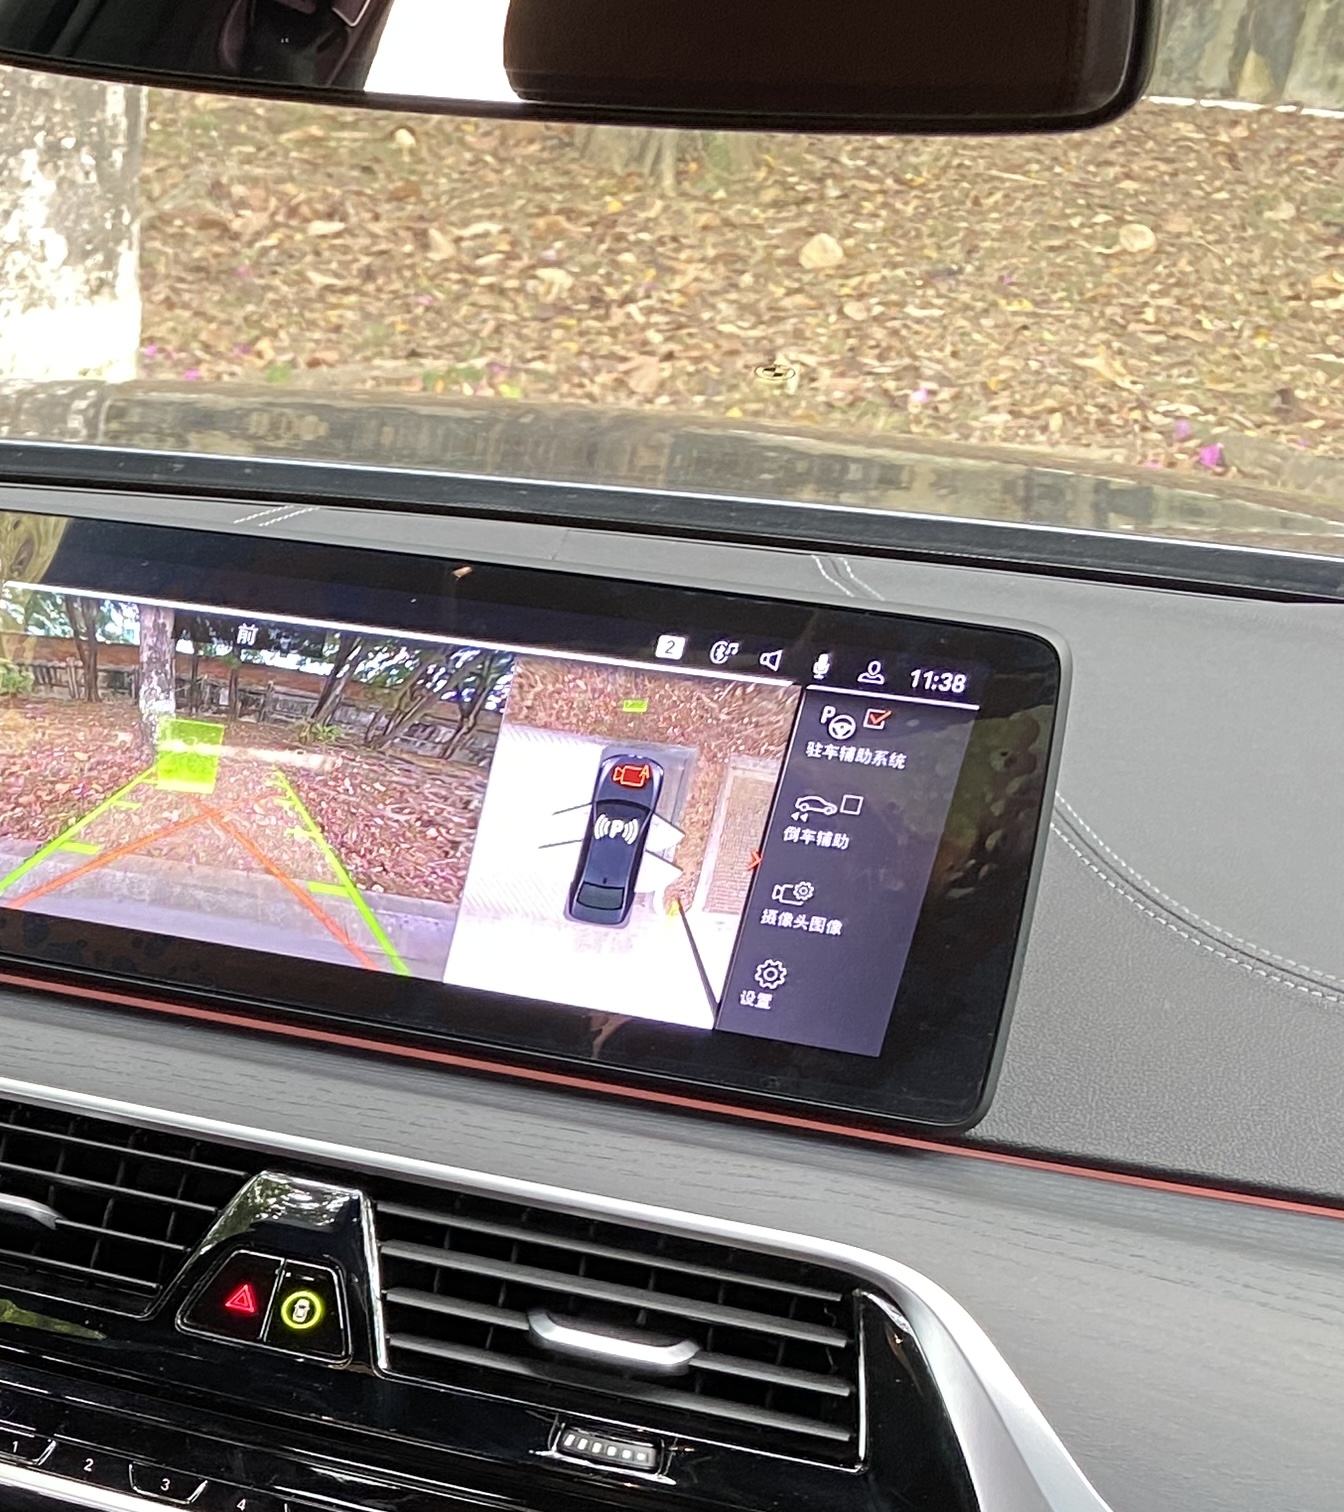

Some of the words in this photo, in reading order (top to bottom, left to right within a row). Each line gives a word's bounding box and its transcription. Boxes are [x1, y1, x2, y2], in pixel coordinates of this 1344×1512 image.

[237, 622, 259, 646] 前
[664, 639, 675, 655] 2
[910, 668, 968, 693] 11:38
[805, 741, 908, 770] 驻车辅助系统
[783, 826, 850, 850] 倒车辅助
[760, 908, 844, 936] 摄像头图像
[739, 989, 773, 1010] 设置
[12, 1440, 19, 1453] 1
[83, 1458, 94, 1472] 2
[160, 1478, 171, 1491] 3
[236, 1498, 246, 1512] 4
